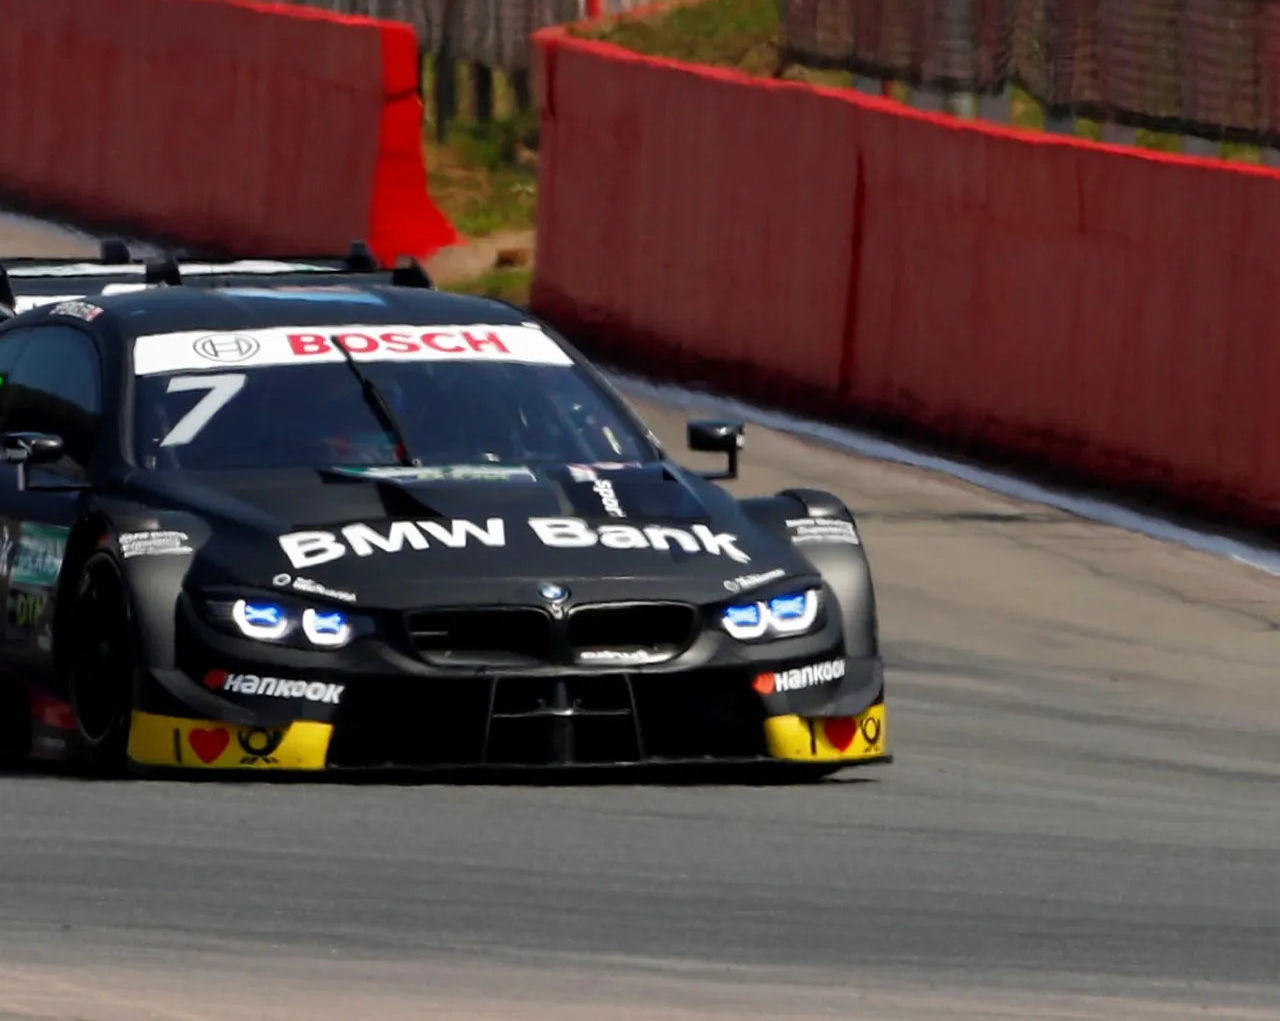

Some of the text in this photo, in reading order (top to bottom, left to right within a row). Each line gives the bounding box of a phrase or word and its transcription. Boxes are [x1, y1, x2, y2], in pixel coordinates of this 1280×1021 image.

[288, 331, 512, 356] BOSCH
[159, 373, 247, 448] 7
[278, 517, 507, 570] BMW
[528, 516, 752, 565] Bank
